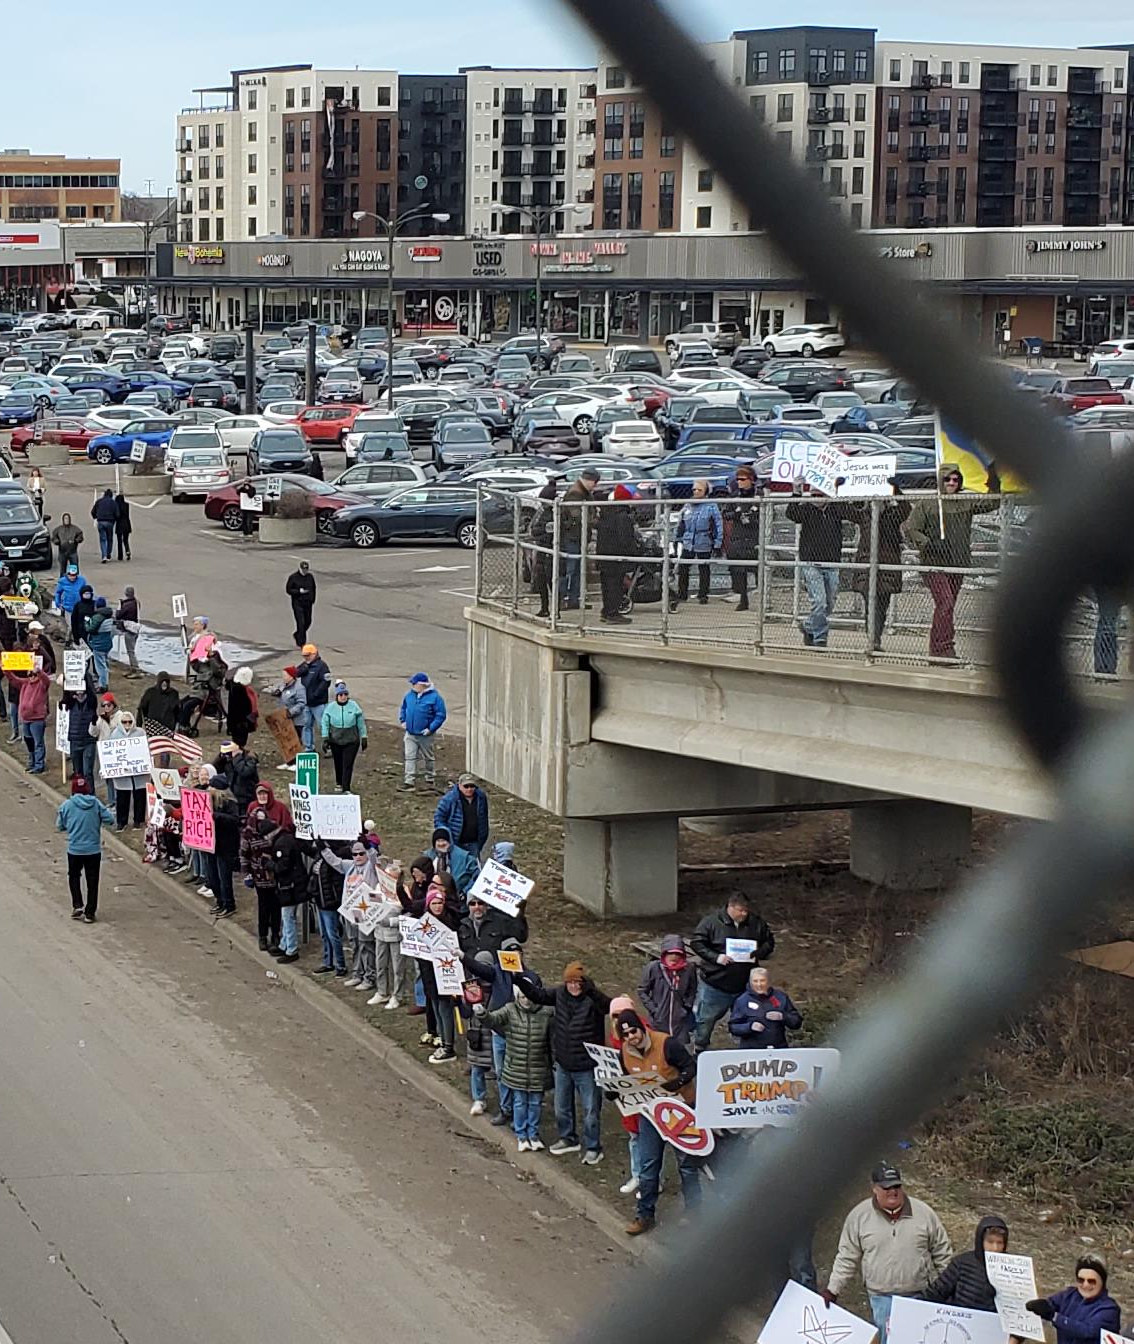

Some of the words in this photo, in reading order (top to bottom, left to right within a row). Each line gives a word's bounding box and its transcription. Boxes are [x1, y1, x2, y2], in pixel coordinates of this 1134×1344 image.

[1036, 240, 1068, 251] JIMMY
[1069, 239, 1104, 251] JOHN'S
[348, 250, 383, 262] NAGOYA
[894, 247, 915, 258] Store
[476, 251, 502, 267] USED
[777, 441, 823, 464] ICE
[778, 461, 804, 479] OU
[843, 459, 869, 472] Jesus
[104, 741, 115, 750] SAY
[115, 739, 127, 749] NO
[128, 738, 141, 748] TO
[298, 758, 317, 770] MILE
[105, 767, 125, 777] VOTE
[291, 789, 310, 800] NO
[183, 791, 211, 812] TAX
[190, 810, 205, 821] THE
[294, 812, 312, 823] NO
[185, 820, 213, 839] RICH
[720, 1059, 798, 1082] DUMP
[604, 1079, 633, 1092] NO
[723, 1105, 758, 1117] SAVE
